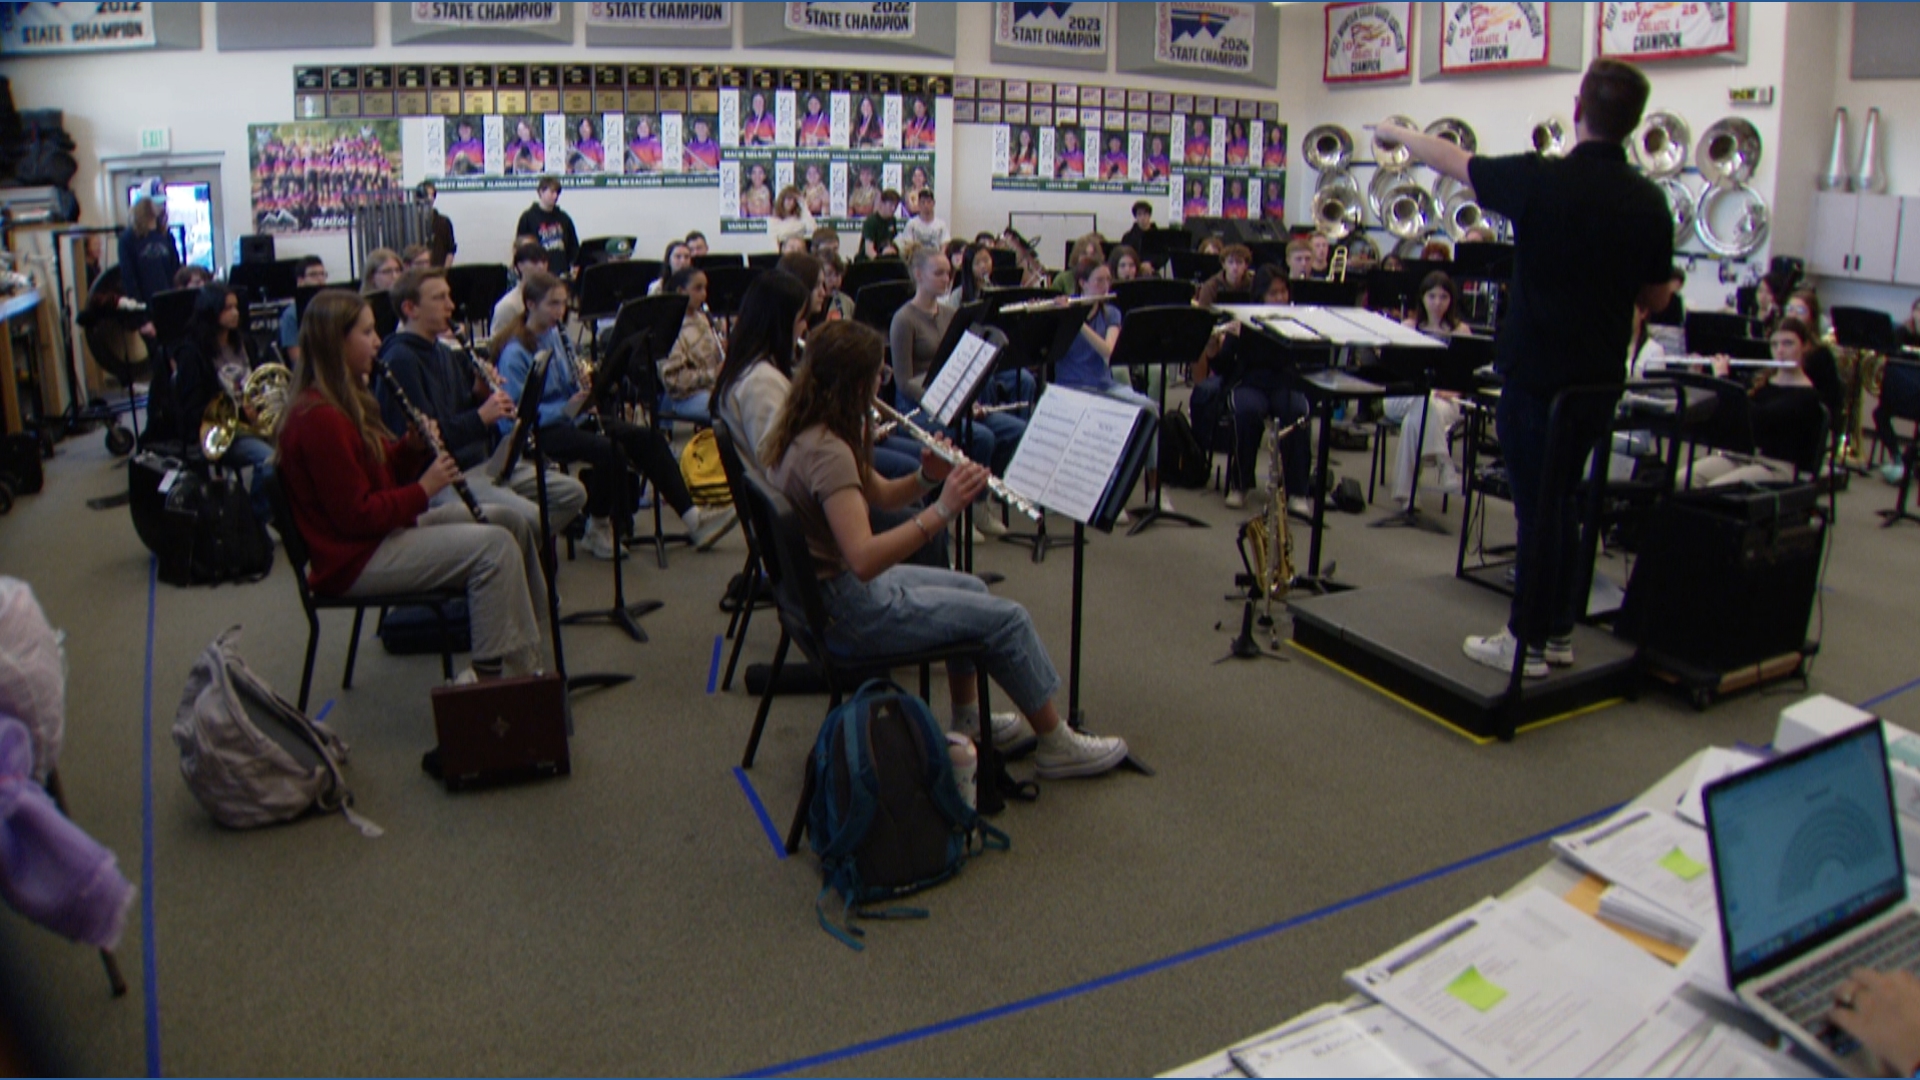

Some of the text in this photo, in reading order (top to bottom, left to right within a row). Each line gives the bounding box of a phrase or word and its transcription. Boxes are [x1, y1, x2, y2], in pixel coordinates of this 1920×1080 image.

[432, 2, 474, 20] STATE
[477, 2, 553, 21] CHAMPION
[606, 2, 647, 19] STATE
[650, 2, 722, 21] CHAMPION
[805, 9, 842, 27] STATE
[845, 12, 910, 32] CHAMPION
[22, 21, 143, 45] STATE CHAMPION
[1069, 16, 1101, 31] 2023
[1012, 26, 1101, 48] STATE CHAMPION
[1221, 36, 1250, 52] 2024
[1633, 32, 1682, 53] CHAMPION
[1170, 46, 1248, 68] STATE CHAMPION
[1469, 44, 1509, 63] CHAMPION
[1351, 60, 1381, 75] CHAMPION
